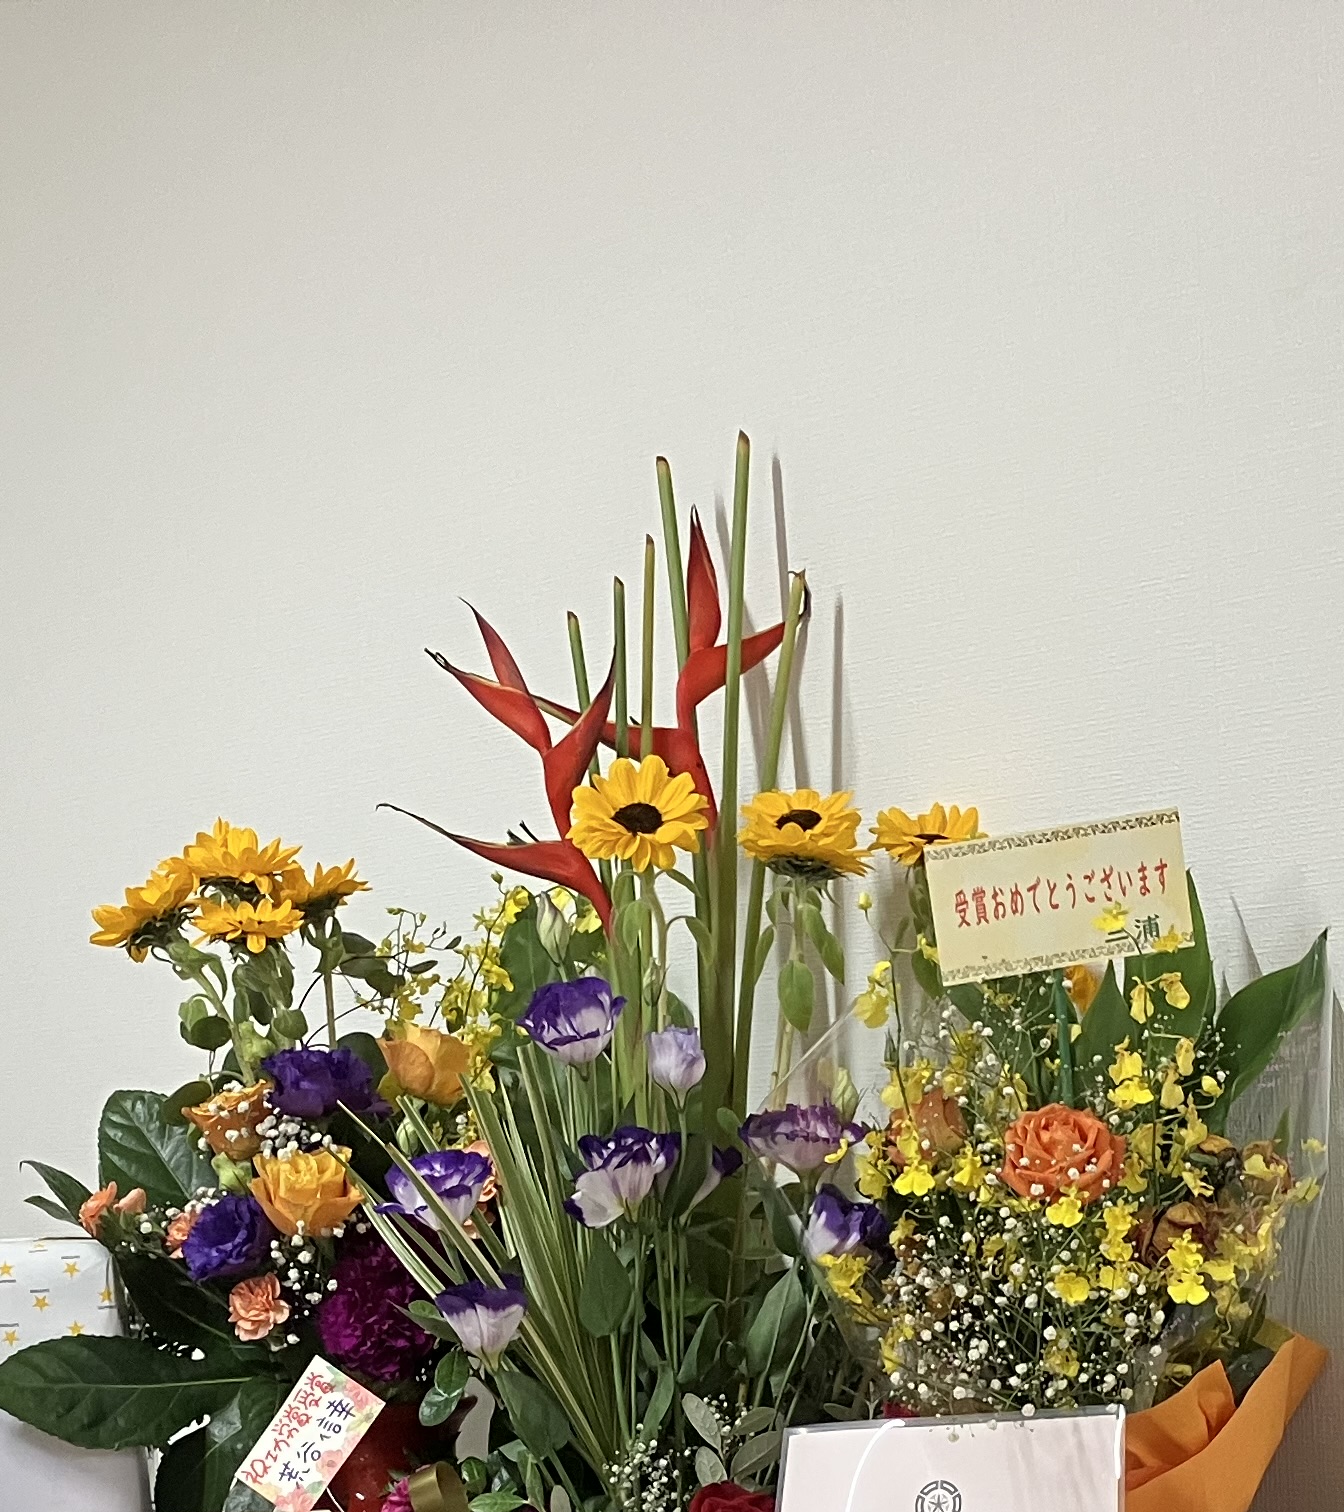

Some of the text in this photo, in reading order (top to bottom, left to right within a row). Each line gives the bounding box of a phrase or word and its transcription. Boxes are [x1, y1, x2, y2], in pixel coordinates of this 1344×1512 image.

[954, 857, 1168, 928] 受賞おめでとうございます
